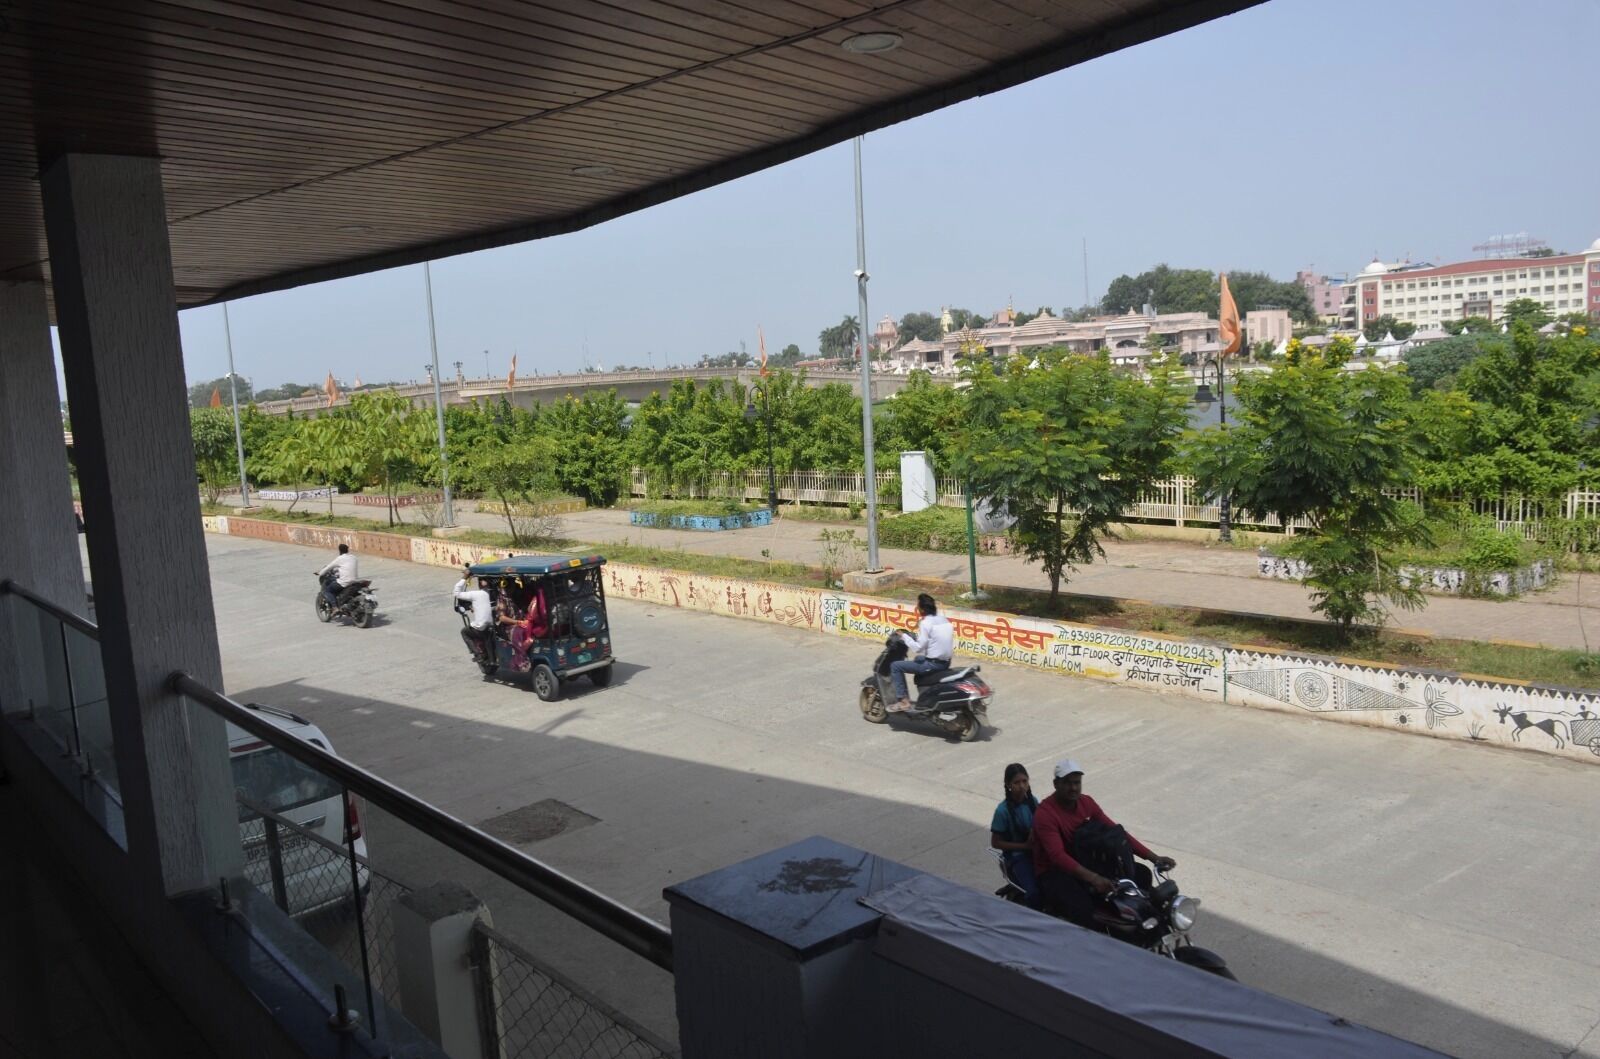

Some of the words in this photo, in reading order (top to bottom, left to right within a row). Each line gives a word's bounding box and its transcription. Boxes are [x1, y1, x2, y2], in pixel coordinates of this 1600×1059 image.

[840, 614, 848, 631] 1
[947, 617, 1054, 650] क्सेस
[1083, 647, 1112, 663] FLOOR
